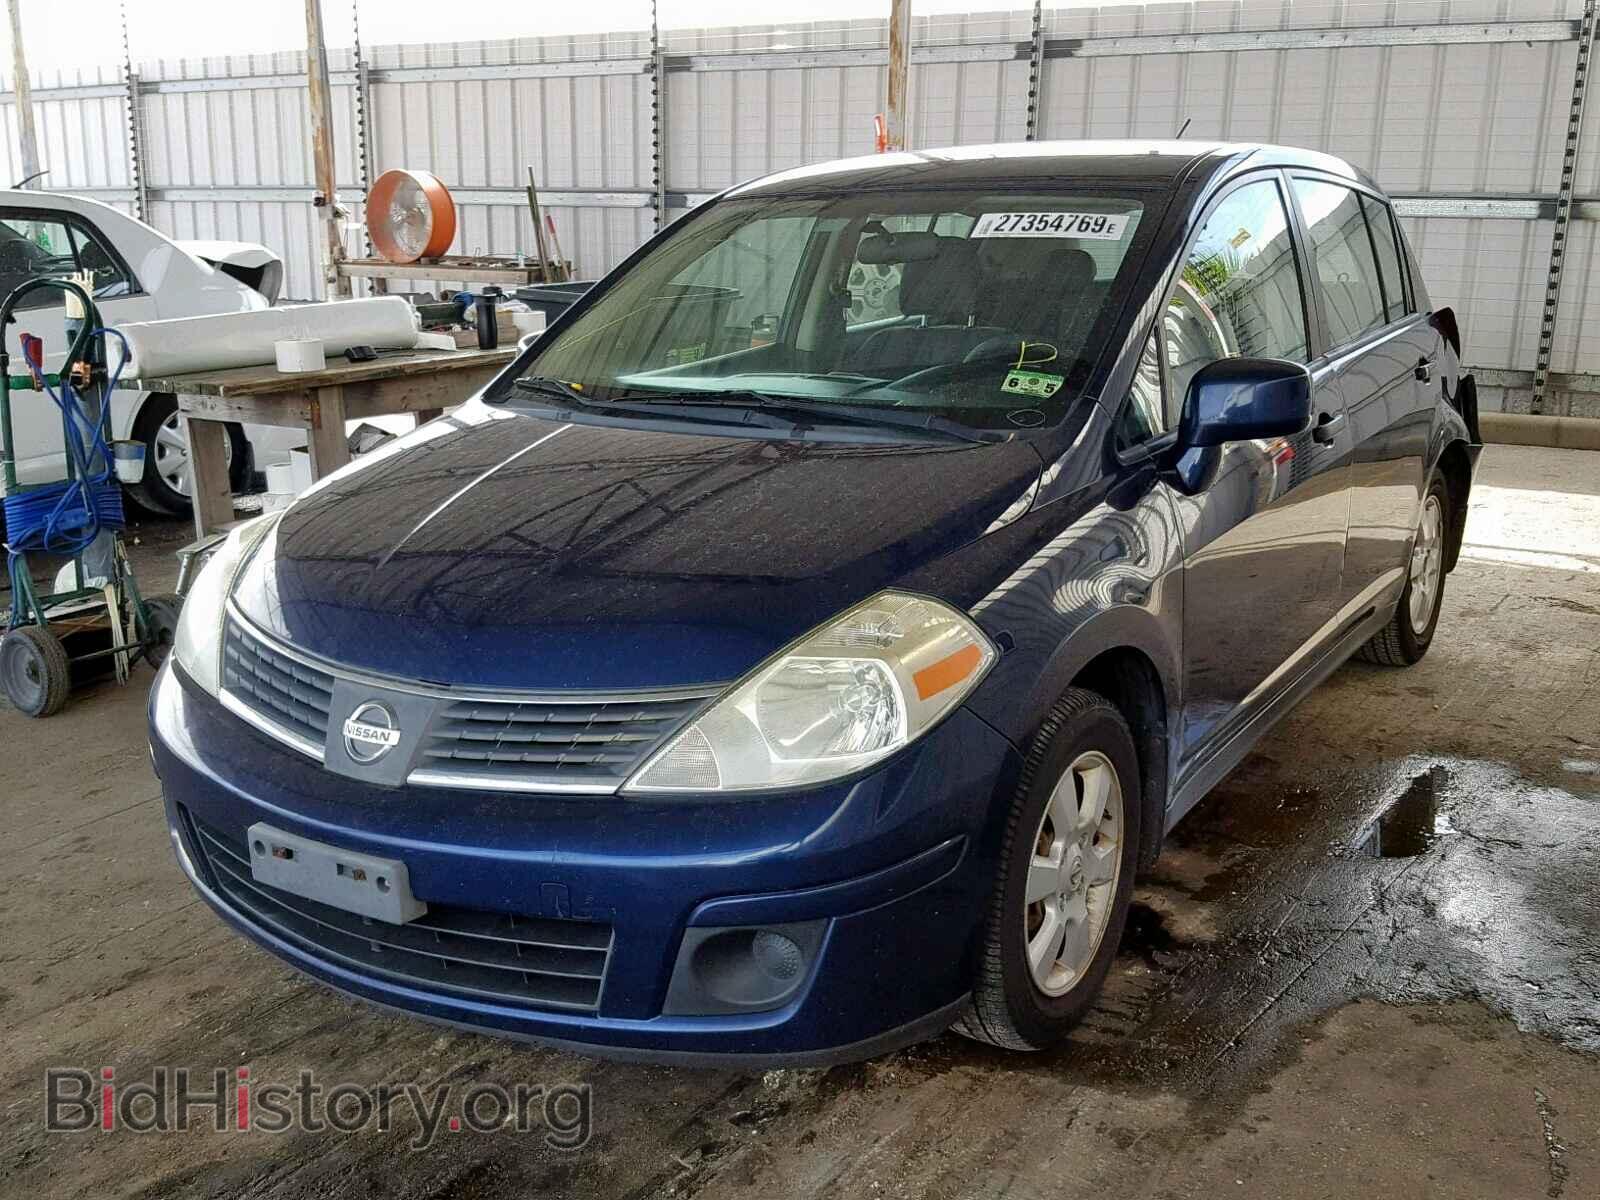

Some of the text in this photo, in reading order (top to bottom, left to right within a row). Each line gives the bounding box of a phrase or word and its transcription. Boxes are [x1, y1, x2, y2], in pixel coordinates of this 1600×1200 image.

[993, 214, 1108, 234] 27354769
[1008, 378, 1020, 388] 6
[1044, 383, 1056, 394] 5
[346, 724, 391, 742] NISSAN
